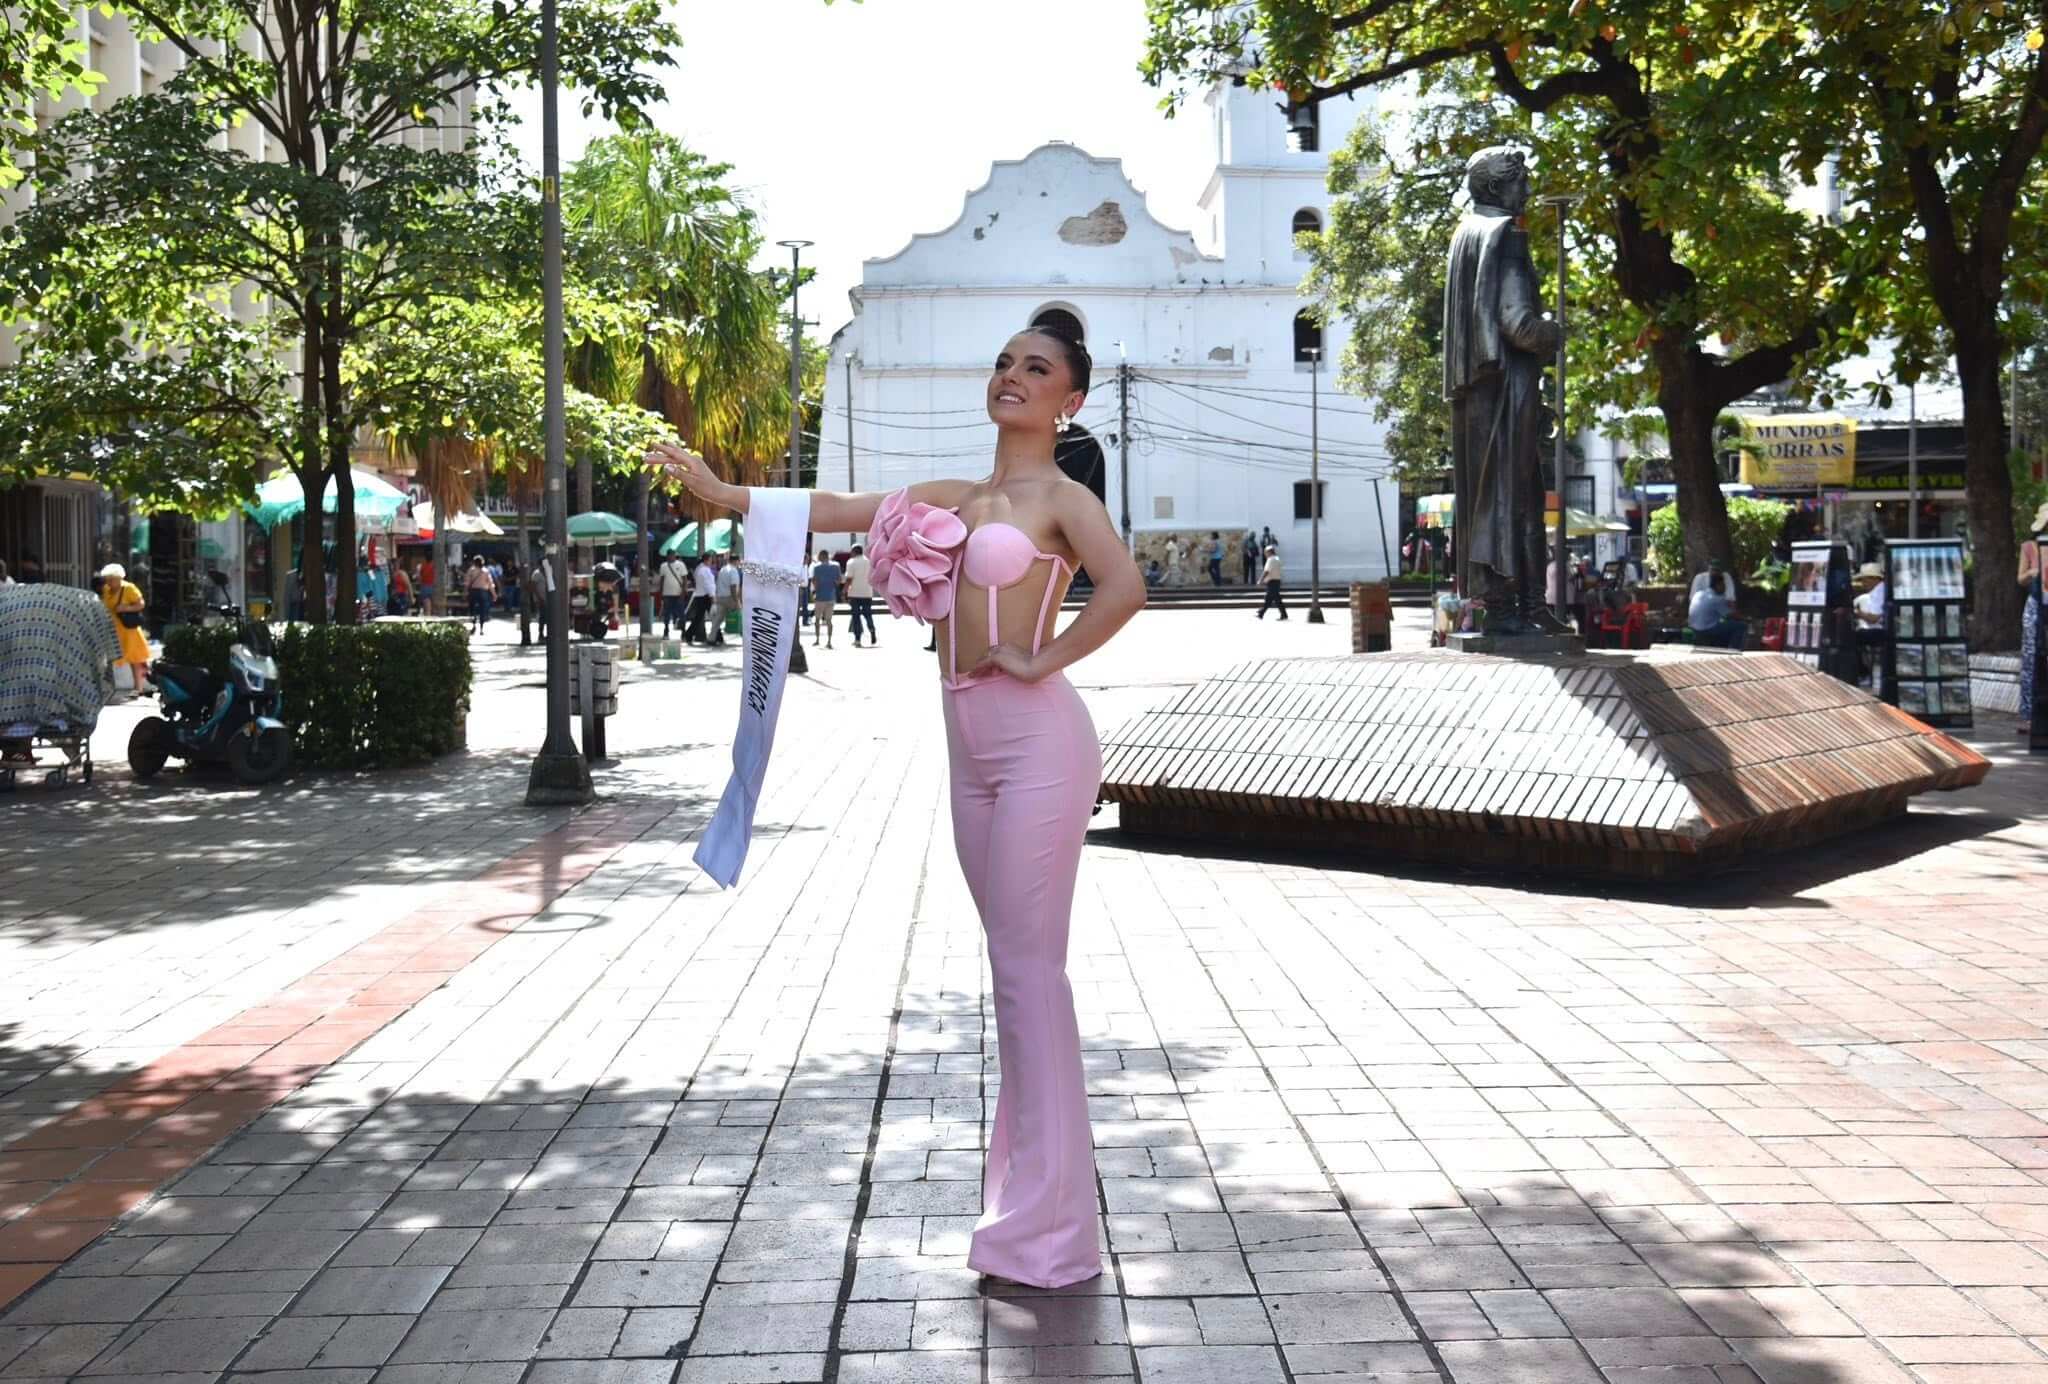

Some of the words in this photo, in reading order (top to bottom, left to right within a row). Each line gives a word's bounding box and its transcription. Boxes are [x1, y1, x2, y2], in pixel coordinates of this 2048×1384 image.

[1756, 425, 1827, 439] MUNDO
[1765, 442, 1845, 458] ORRAS
[748, 607, 782, 717] CUNDINAMARCA
